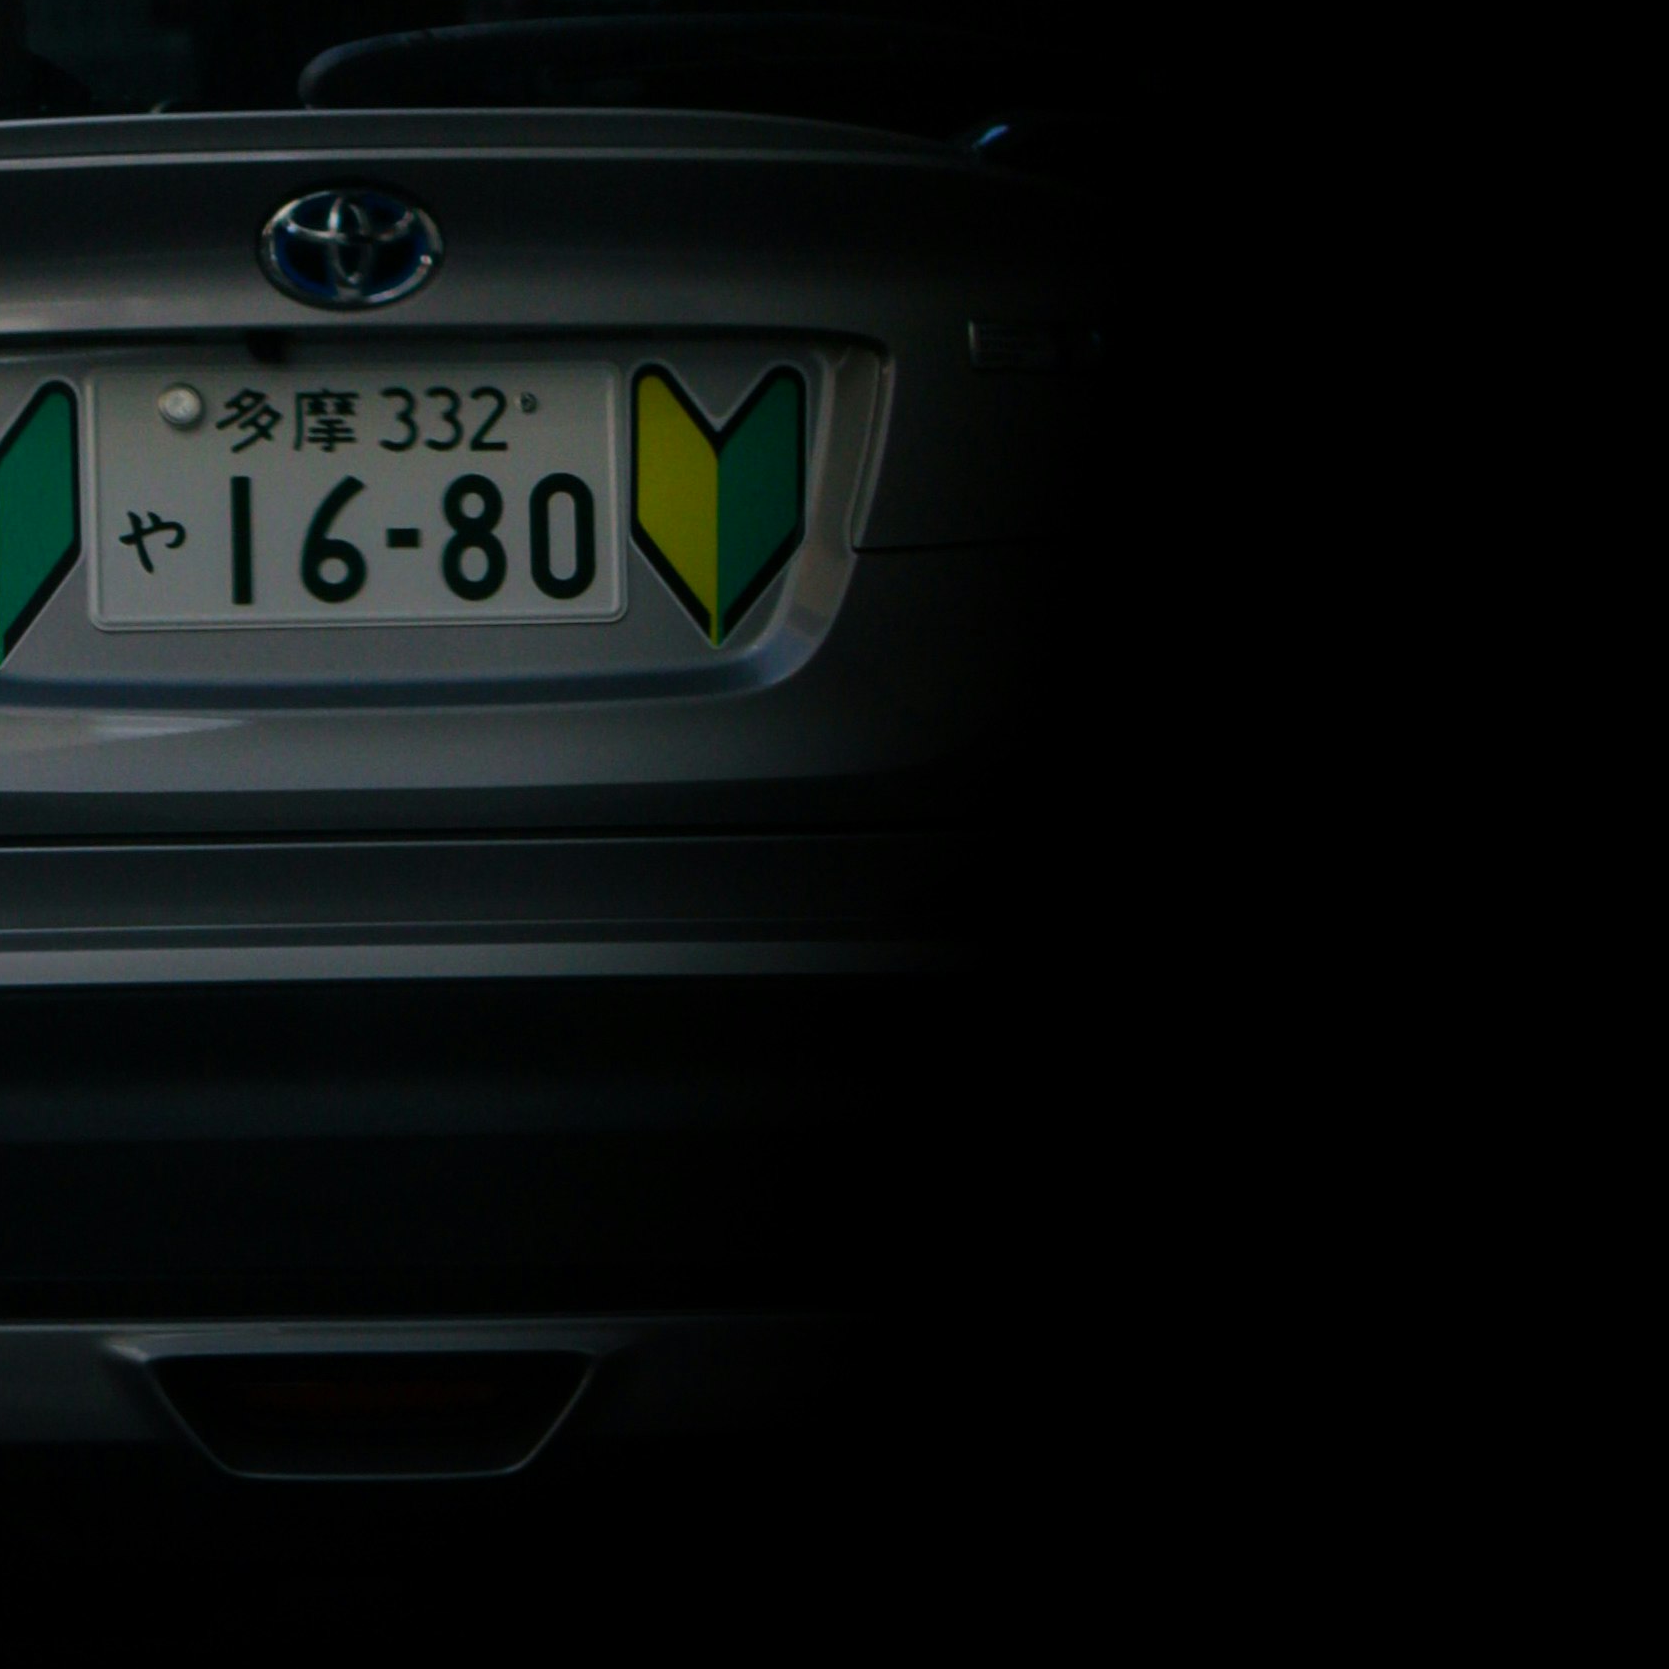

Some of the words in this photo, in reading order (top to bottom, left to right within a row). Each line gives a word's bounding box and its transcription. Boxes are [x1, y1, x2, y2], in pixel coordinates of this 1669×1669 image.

[216, 387, 360, 452] 多摩
[380, 386, 508, 451] 332
[119, 510, 186, 573] や
[231, 472, 595, 603] 16-80
